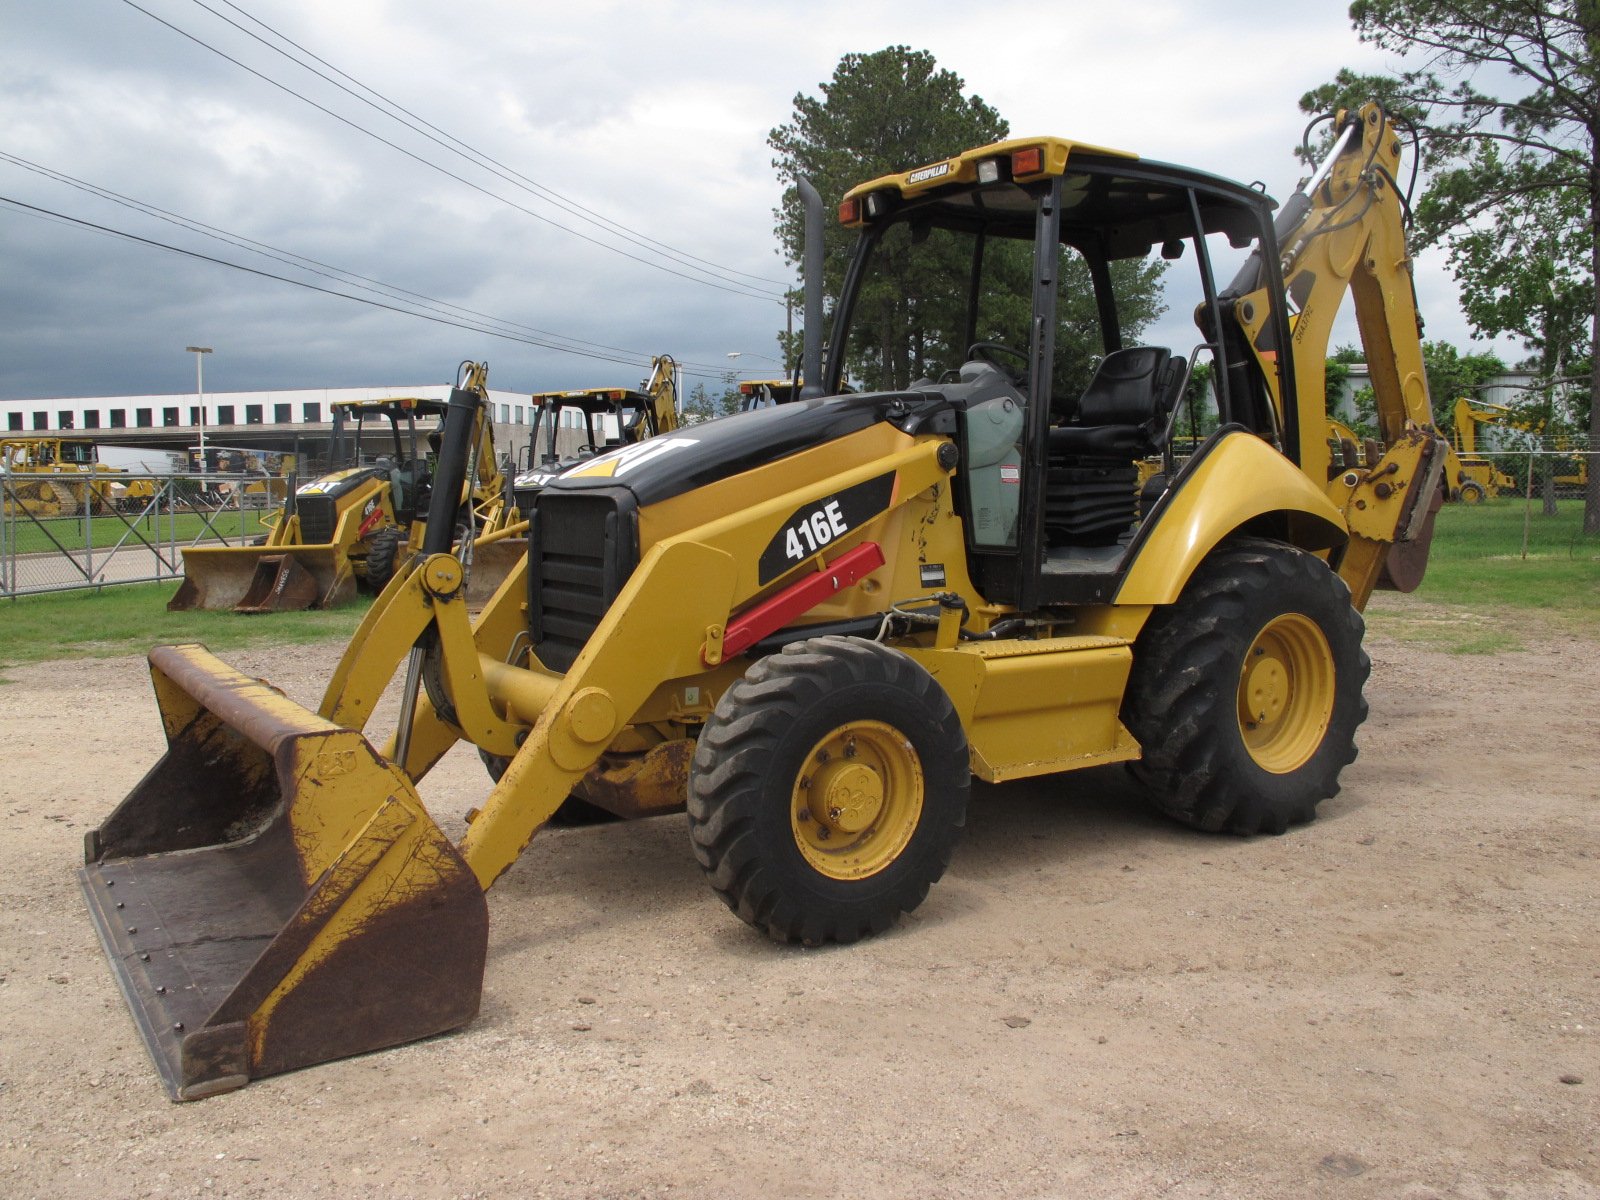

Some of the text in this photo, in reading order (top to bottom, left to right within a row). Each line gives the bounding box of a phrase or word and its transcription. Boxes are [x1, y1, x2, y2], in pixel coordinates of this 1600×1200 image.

[910, 164, 948, 184] CATERPILLAR
[559, 438, 701, 480] CAT
[296, 482, 342, 495] CAT
[513, 474, 557, 487] CAT
[786, 500, 848, 560] 416E
